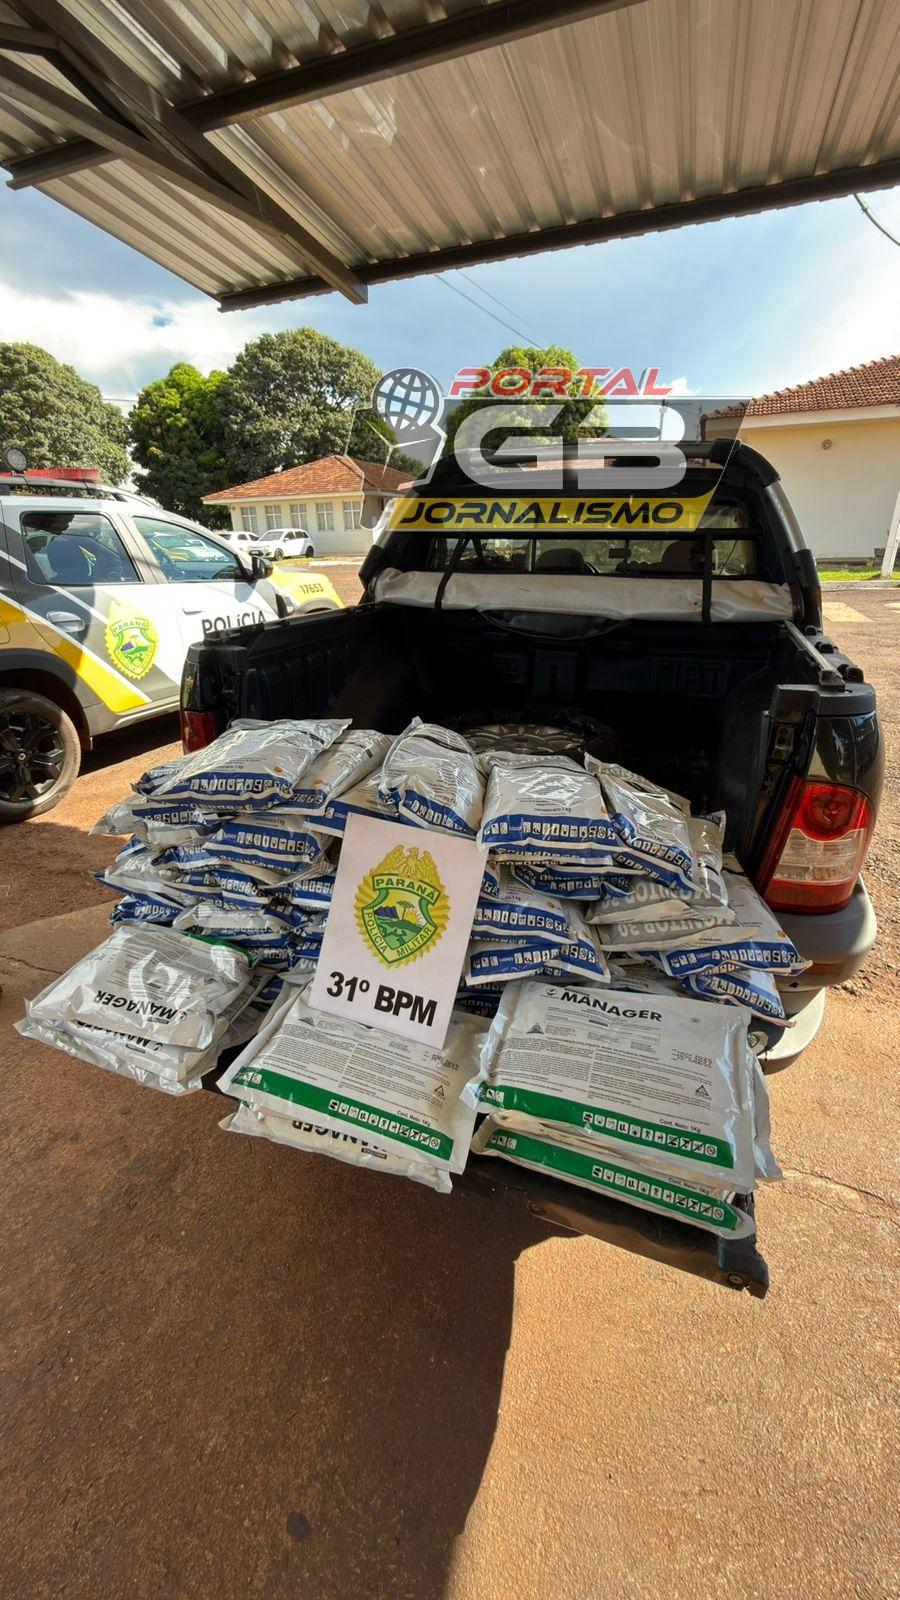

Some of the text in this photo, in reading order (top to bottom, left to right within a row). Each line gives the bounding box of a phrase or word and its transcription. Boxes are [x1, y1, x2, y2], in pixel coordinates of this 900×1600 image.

[299, 582, 324, 594] 17653
[375, 878, 436, 902] PARANÁ
[395, 926, 434, 958] MILITAR
[618, 923, 641, 938] 30
[93, 990, 178, 1020] MANAGER
[374, 984, 438, 1027] BPM
[560, 991, 663, 1022] MANAGER
